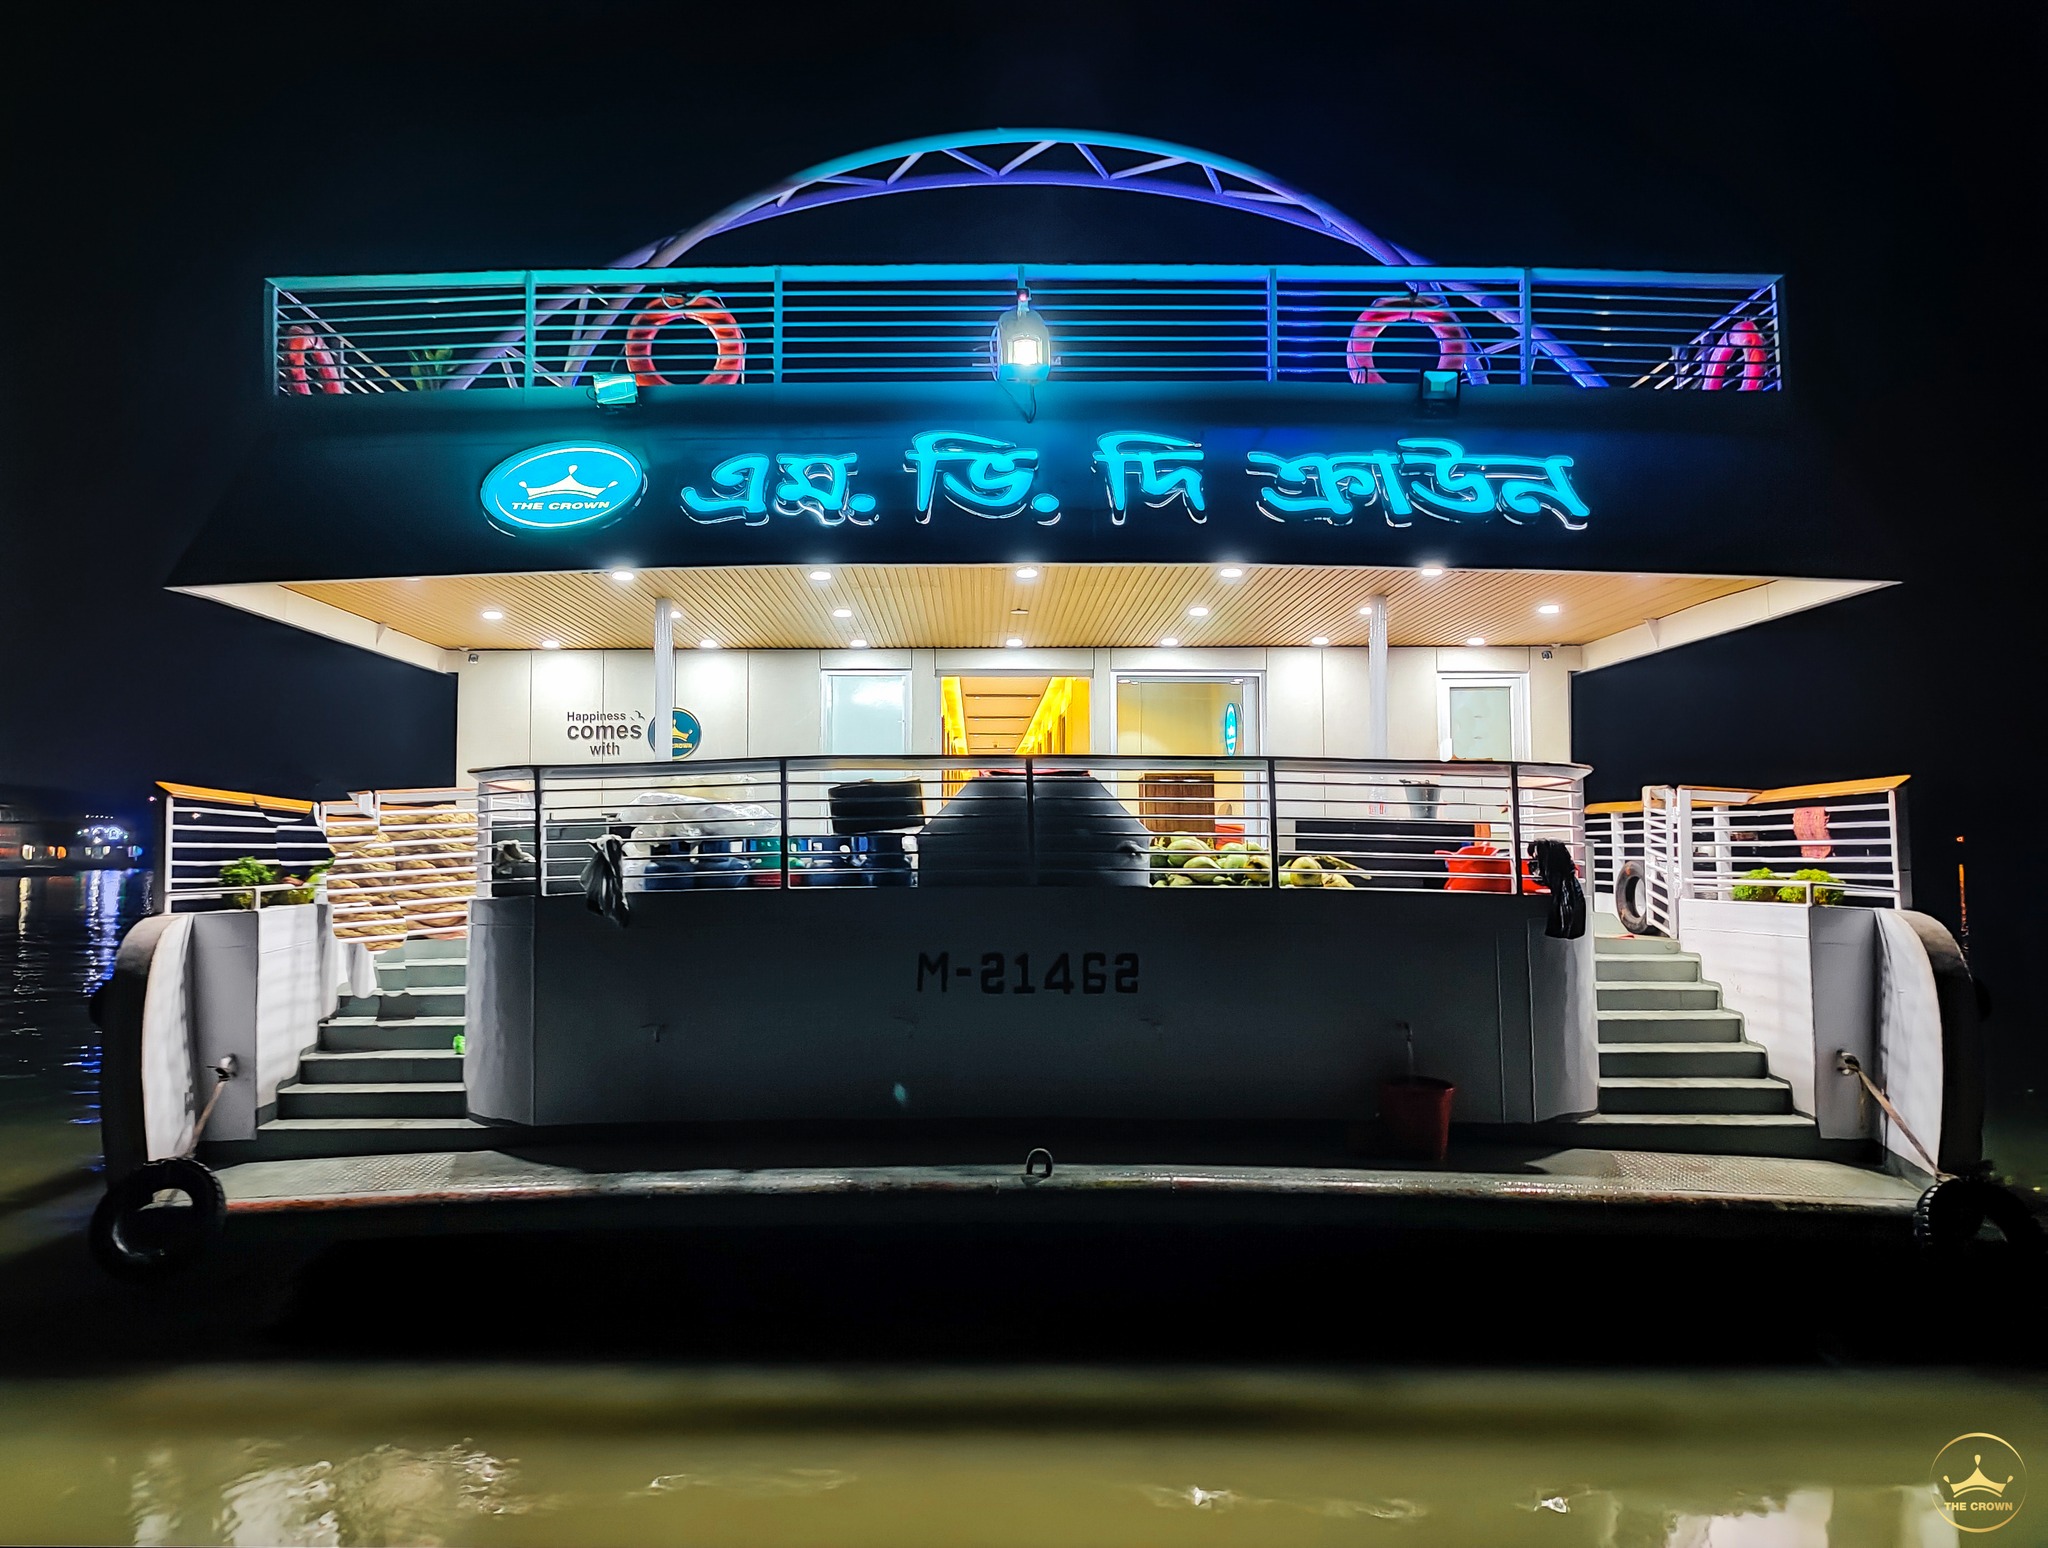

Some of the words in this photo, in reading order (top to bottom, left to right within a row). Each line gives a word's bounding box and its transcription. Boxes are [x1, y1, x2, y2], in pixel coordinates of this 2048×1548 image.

[681, 453, 878, 519] এম.
[904, 430, 1060, 517] ভি.
[1092, 431, 1206, 517] দি
[1247, 438, 1591, 522] ক্রাউন
[511, 502, 544, 510] THE
[548, 501, 610, 510] CROWN
[567, 711, 626, 723] Happiness
[567, 724, 643, 740] comes
[589, 742, 620, 756] with
[916, 951, 1140, 995] M-21462
